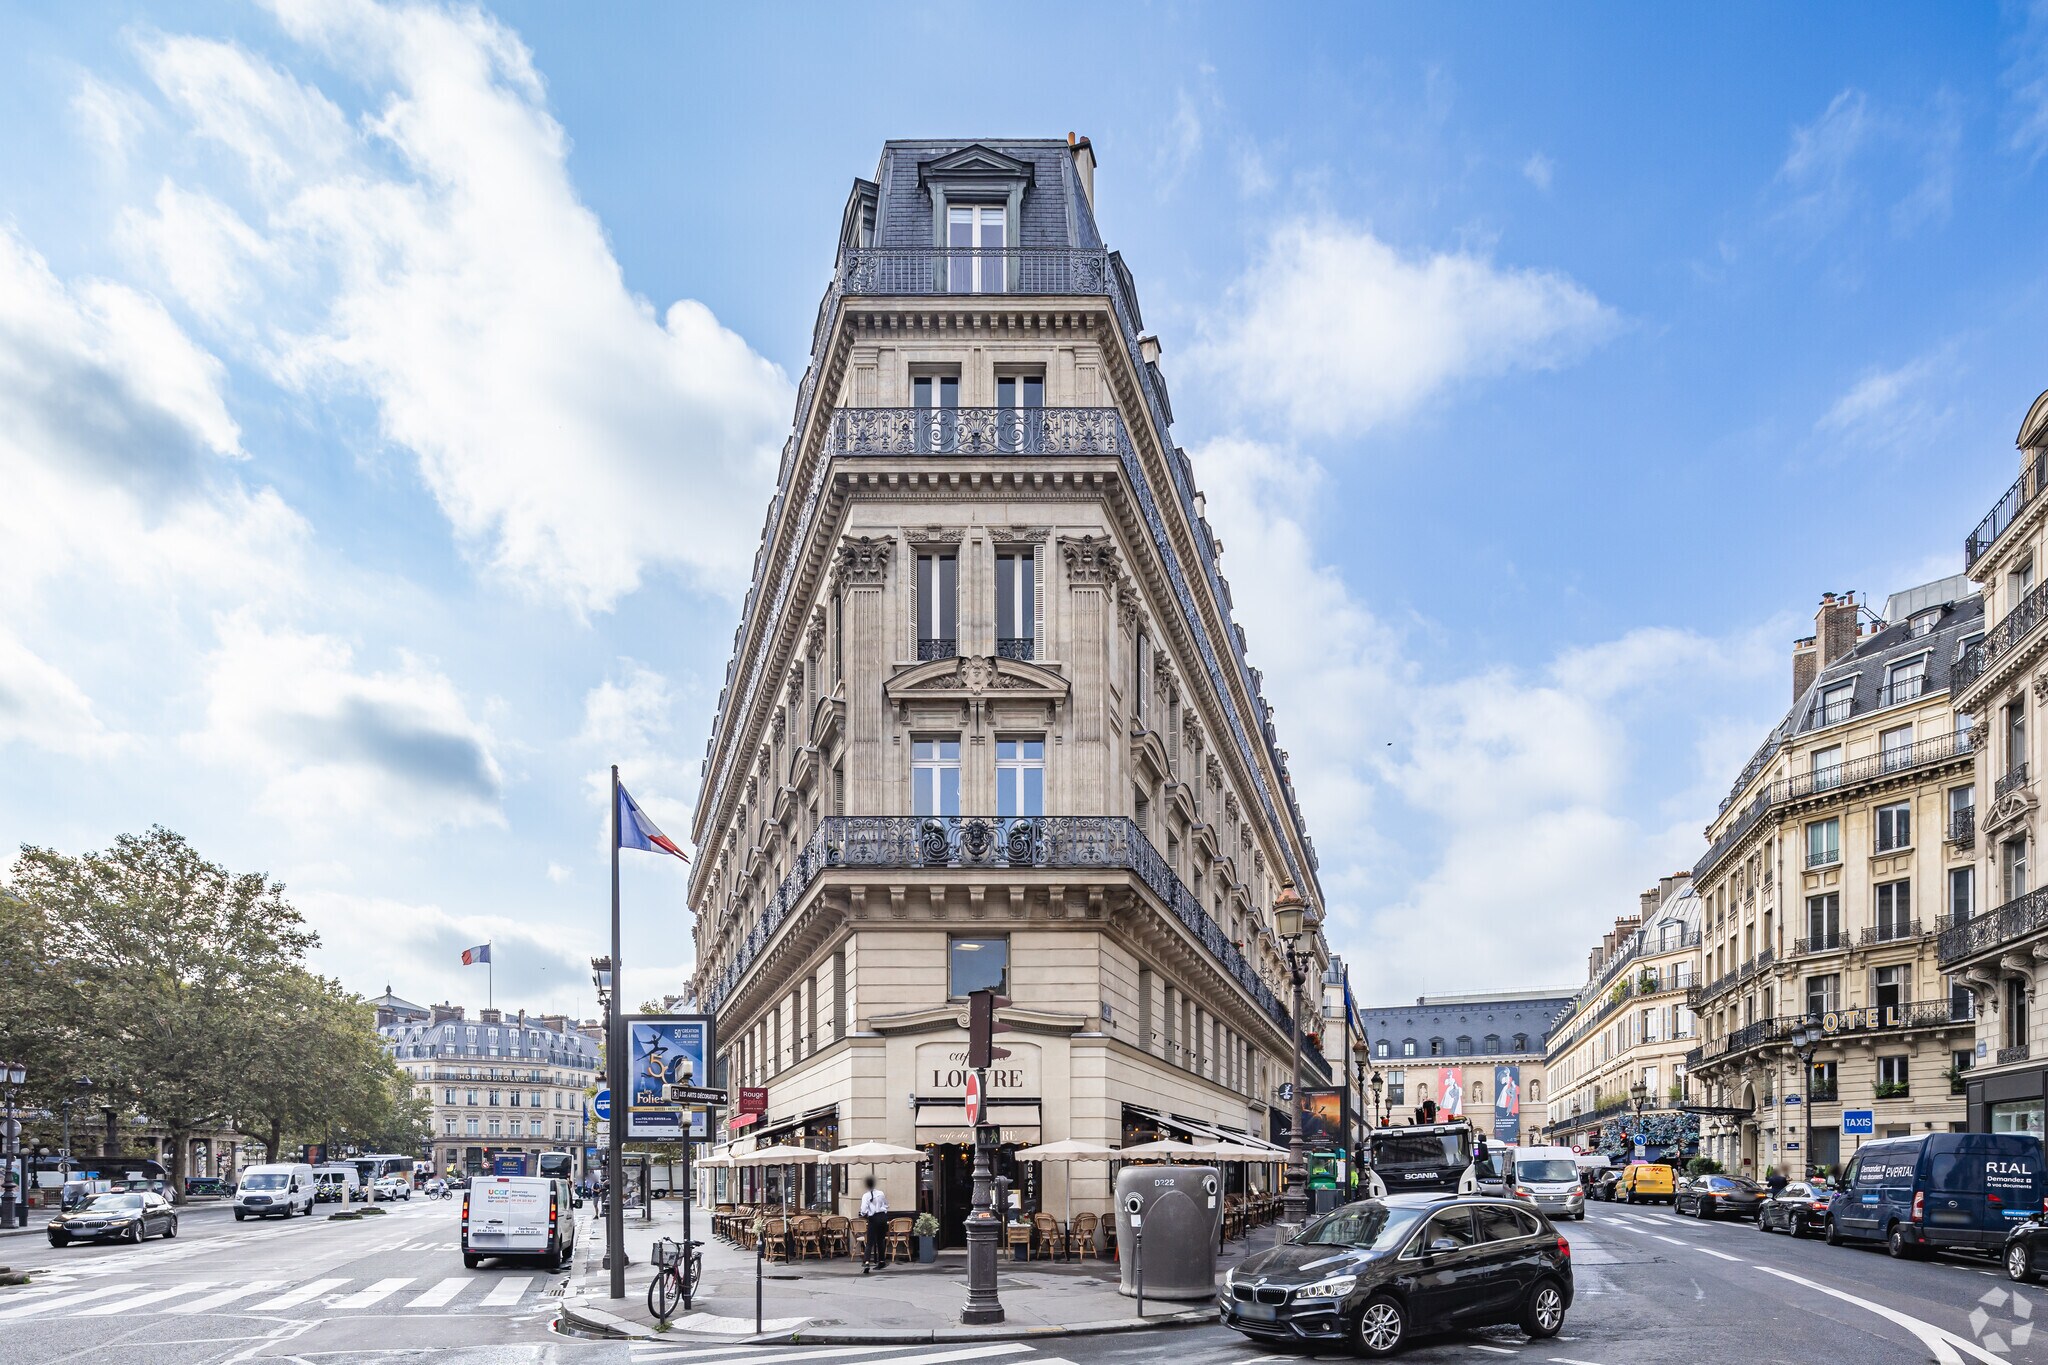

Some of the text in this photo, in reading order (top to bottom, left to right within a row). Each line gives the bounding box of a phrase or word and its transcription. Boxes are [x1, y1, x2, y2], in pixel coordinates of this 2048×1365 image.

[1803, 1007, 1899, 1032] OTEL
[949, 1049, 971, 1066] caf
[637, 1092, 665, 1104] Folies
[697, 1092, 719, 1101] DÉCORATIFS
[743, 1091, 764, 1100] Rouge
[1845, 1118, 1872, 1127] TAXIS
[971, 1131, 1018, 1141] LRE
[1861, 1165, 1881, 1173] Demandez
[1986, 1161, 2032, 1175] RIAL
[1404, 1172, 1438, 1180] SCANIA
